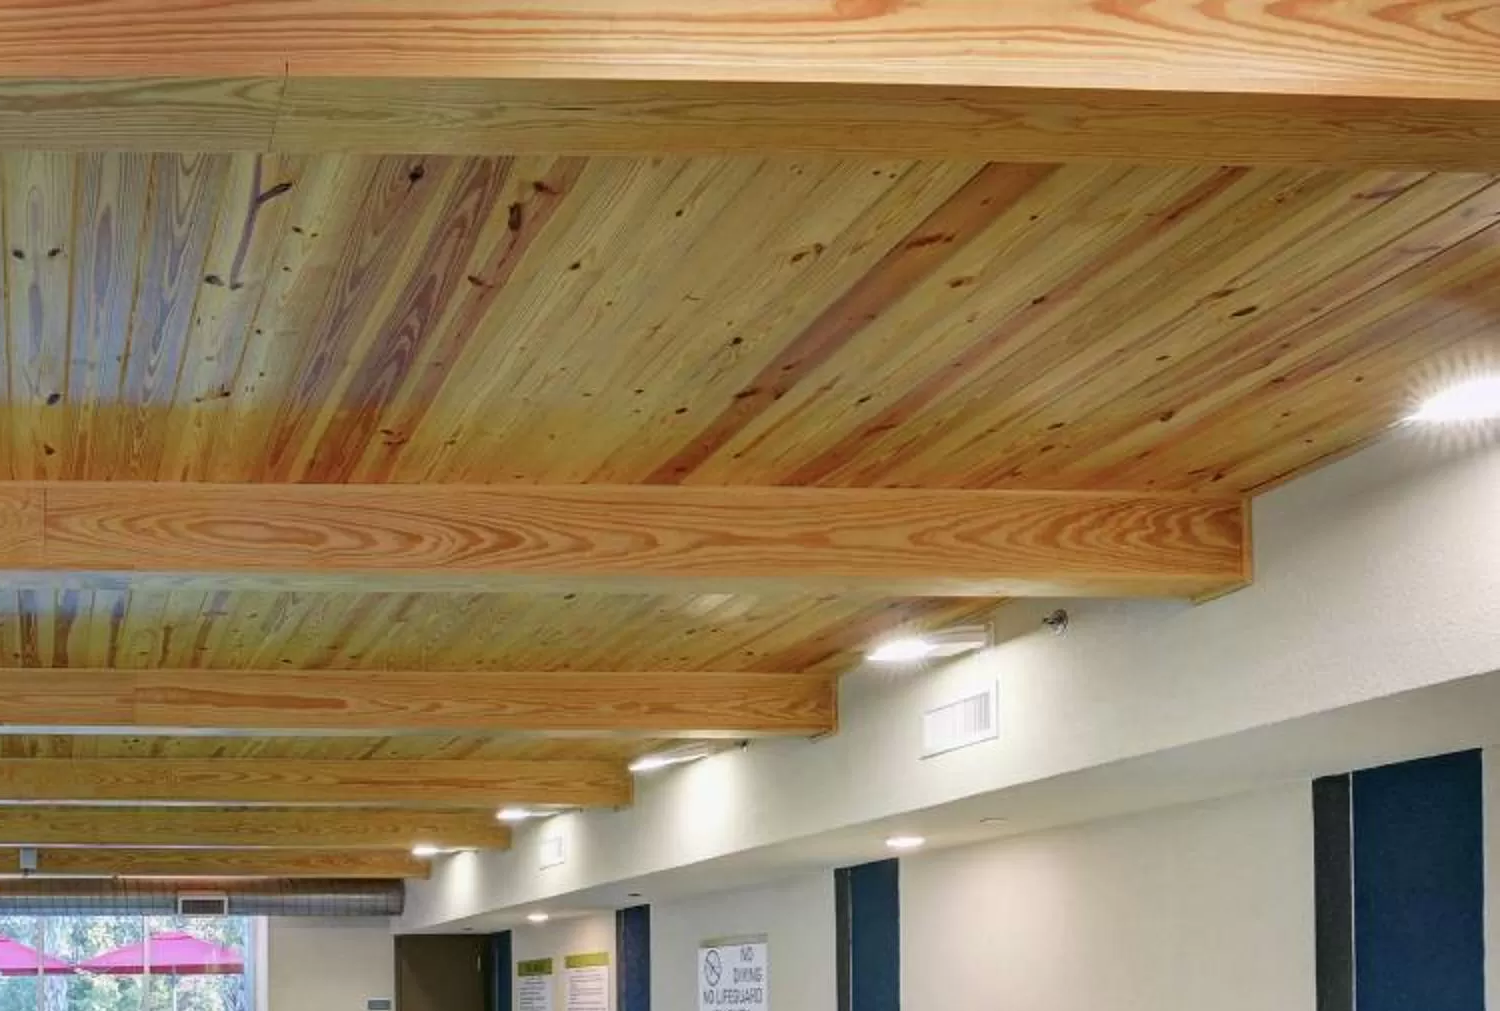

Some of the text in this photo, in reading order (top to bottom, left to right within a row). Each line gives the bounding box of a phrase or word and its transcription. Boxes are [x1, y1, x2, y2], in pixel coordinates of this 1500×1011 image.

[740, 945, 755, 961] NO
[733, 967, 764, 985] DIVING
[703, 988, 763, 1005] NO LIFEGUARD
